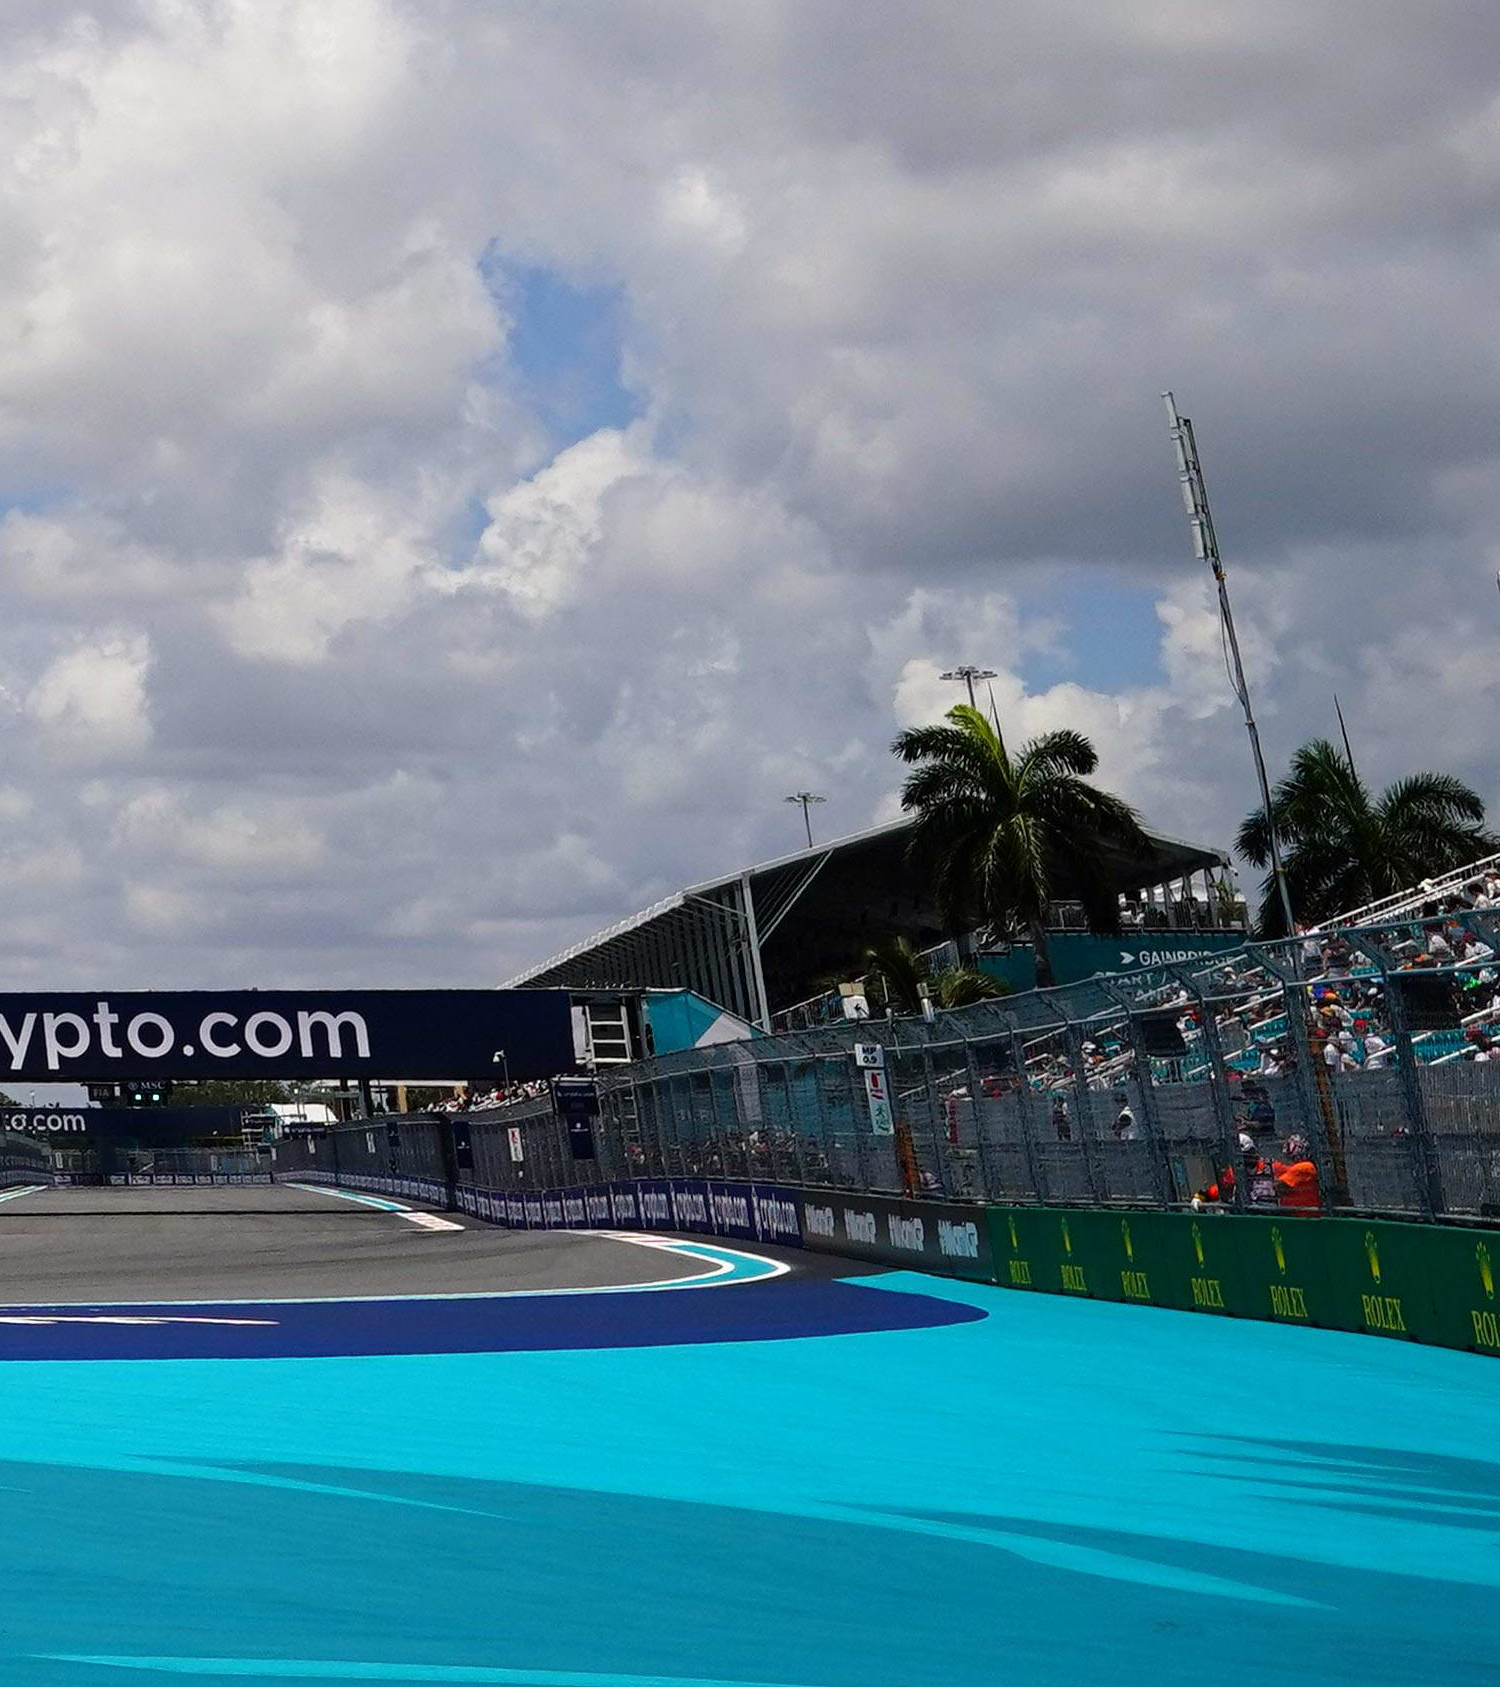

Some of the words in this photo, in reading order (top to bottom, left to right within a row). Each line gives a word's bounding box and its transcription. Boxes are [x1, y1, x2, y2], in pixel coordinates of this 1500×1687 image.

[1060, 1264, 1087, 1291] ROLEX
[1120, 1269, 1150, 1300] ROLEX
[1191, 1277, 1225, 1308] ROLEX
[1268, 1285, 1309, 1319] ROLEX
[1361, 1293, 1407, 1332] ROLEX
